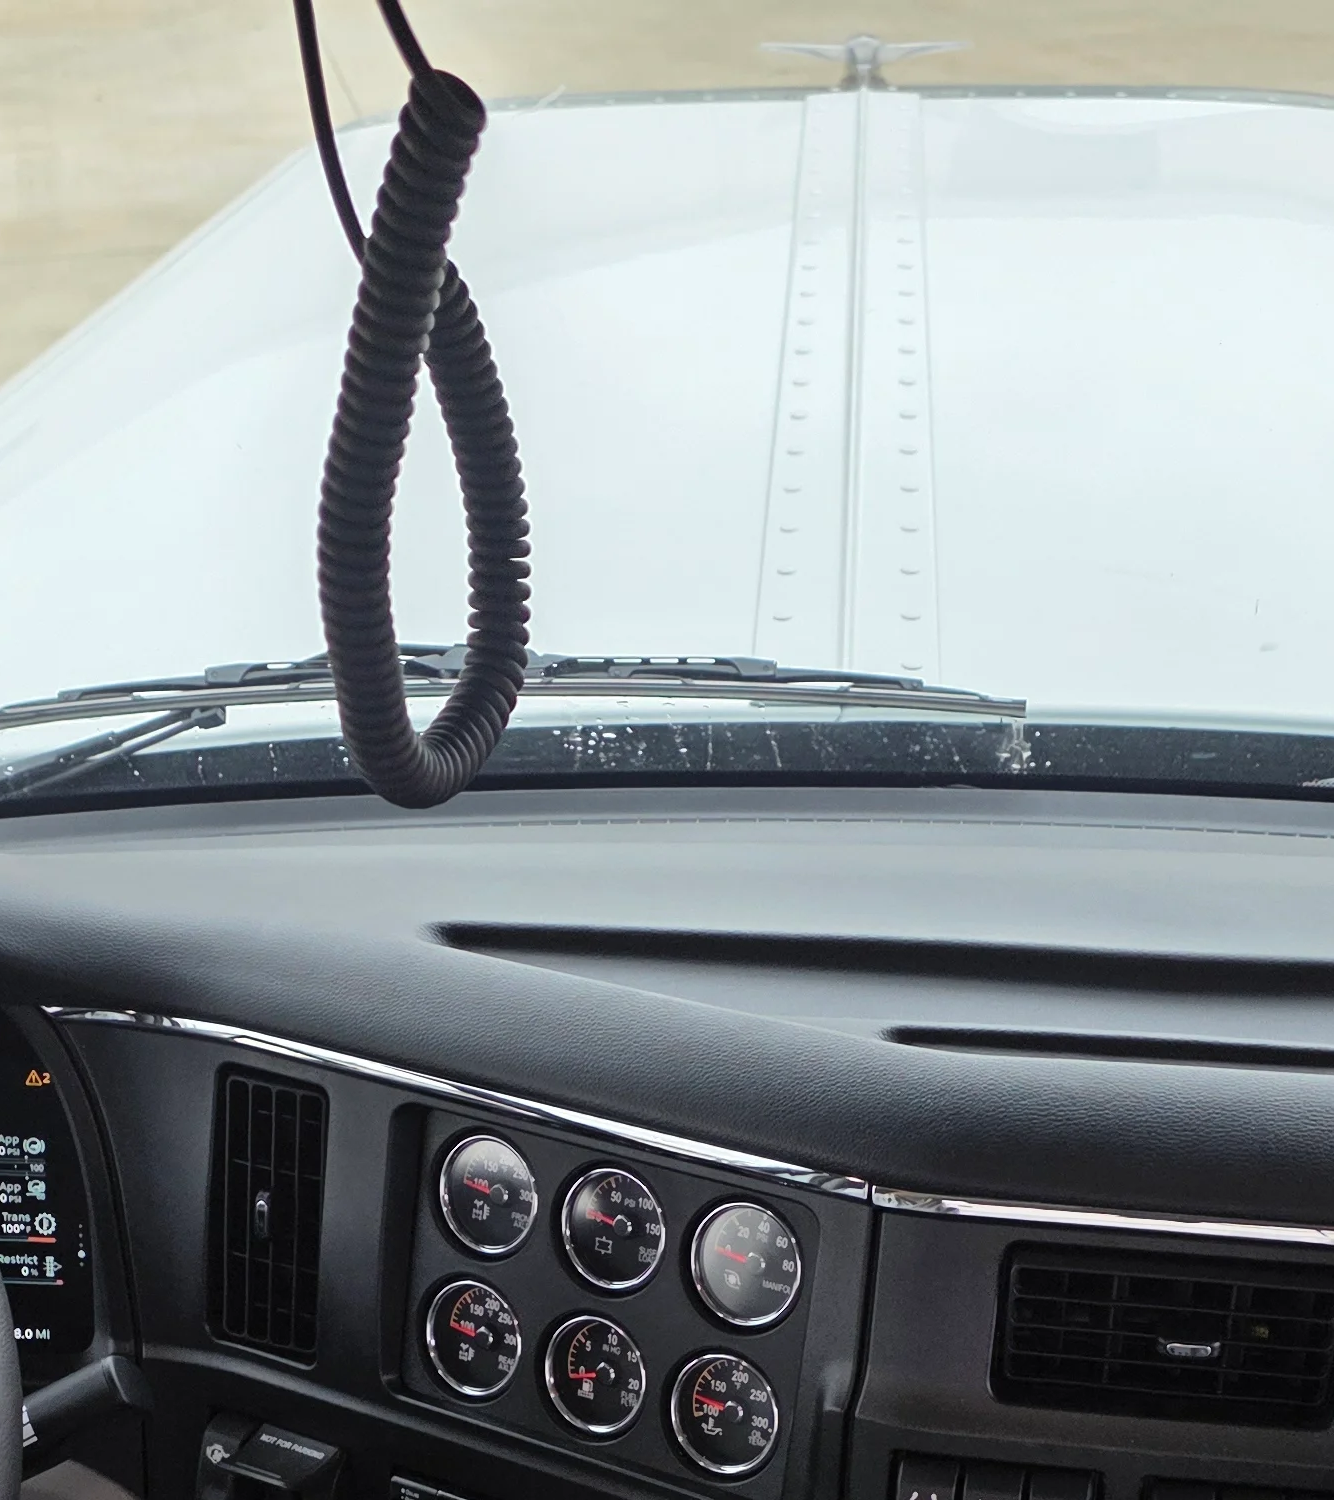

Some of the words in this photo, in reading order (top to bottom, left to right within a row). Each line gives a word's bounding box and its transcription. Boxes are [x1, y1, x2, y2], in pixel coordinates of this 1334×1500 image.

[42, 1073, 51, 1084] 2
[29, 1163, 45, 1172] 100
[483, 1160, 498, 1173] 150
[0, 1182, 22, 1193] App
[0, 1194, 7, 1203] 0
[610, 1191, 622, 1203] 50
[624, 1198, 636, 1208] PSI
[638, 1197, 654, 1211] 100
[1, 1212, 31, 1222] Trans
[645, 1223, 661, 1236] 150
[737, 1226, 750, 1239] 20
[758, 1221, 770, 1234] 40
[776, 1235, 789, 1249] 60
[21, 1266, 29, 1276] 0
[782, 1259, 795, 1272] 80
[469, 1303, 484, 1317] 150
[485, 1298, 500, 1312] 200
[36, 1329, 51, 1340] MI
[607, 1333, 618, 1345] 10
[585, 1340, 592, 1352] 5
[731, 1370, 749, 1384] 200
[628, 1378, 639, 1391] 20
[710, 1380, 727, 1393] 150
[749, 1389, 767, 1403] 250
[702, 1404, 719, 1417] 100
[751, 1415, 769, 1429] 300
[259, 1433, 277, 1444] NOT
[275, 1438, 293, 1449] FOR
[290, 1443, 325, 1460] PARKING
